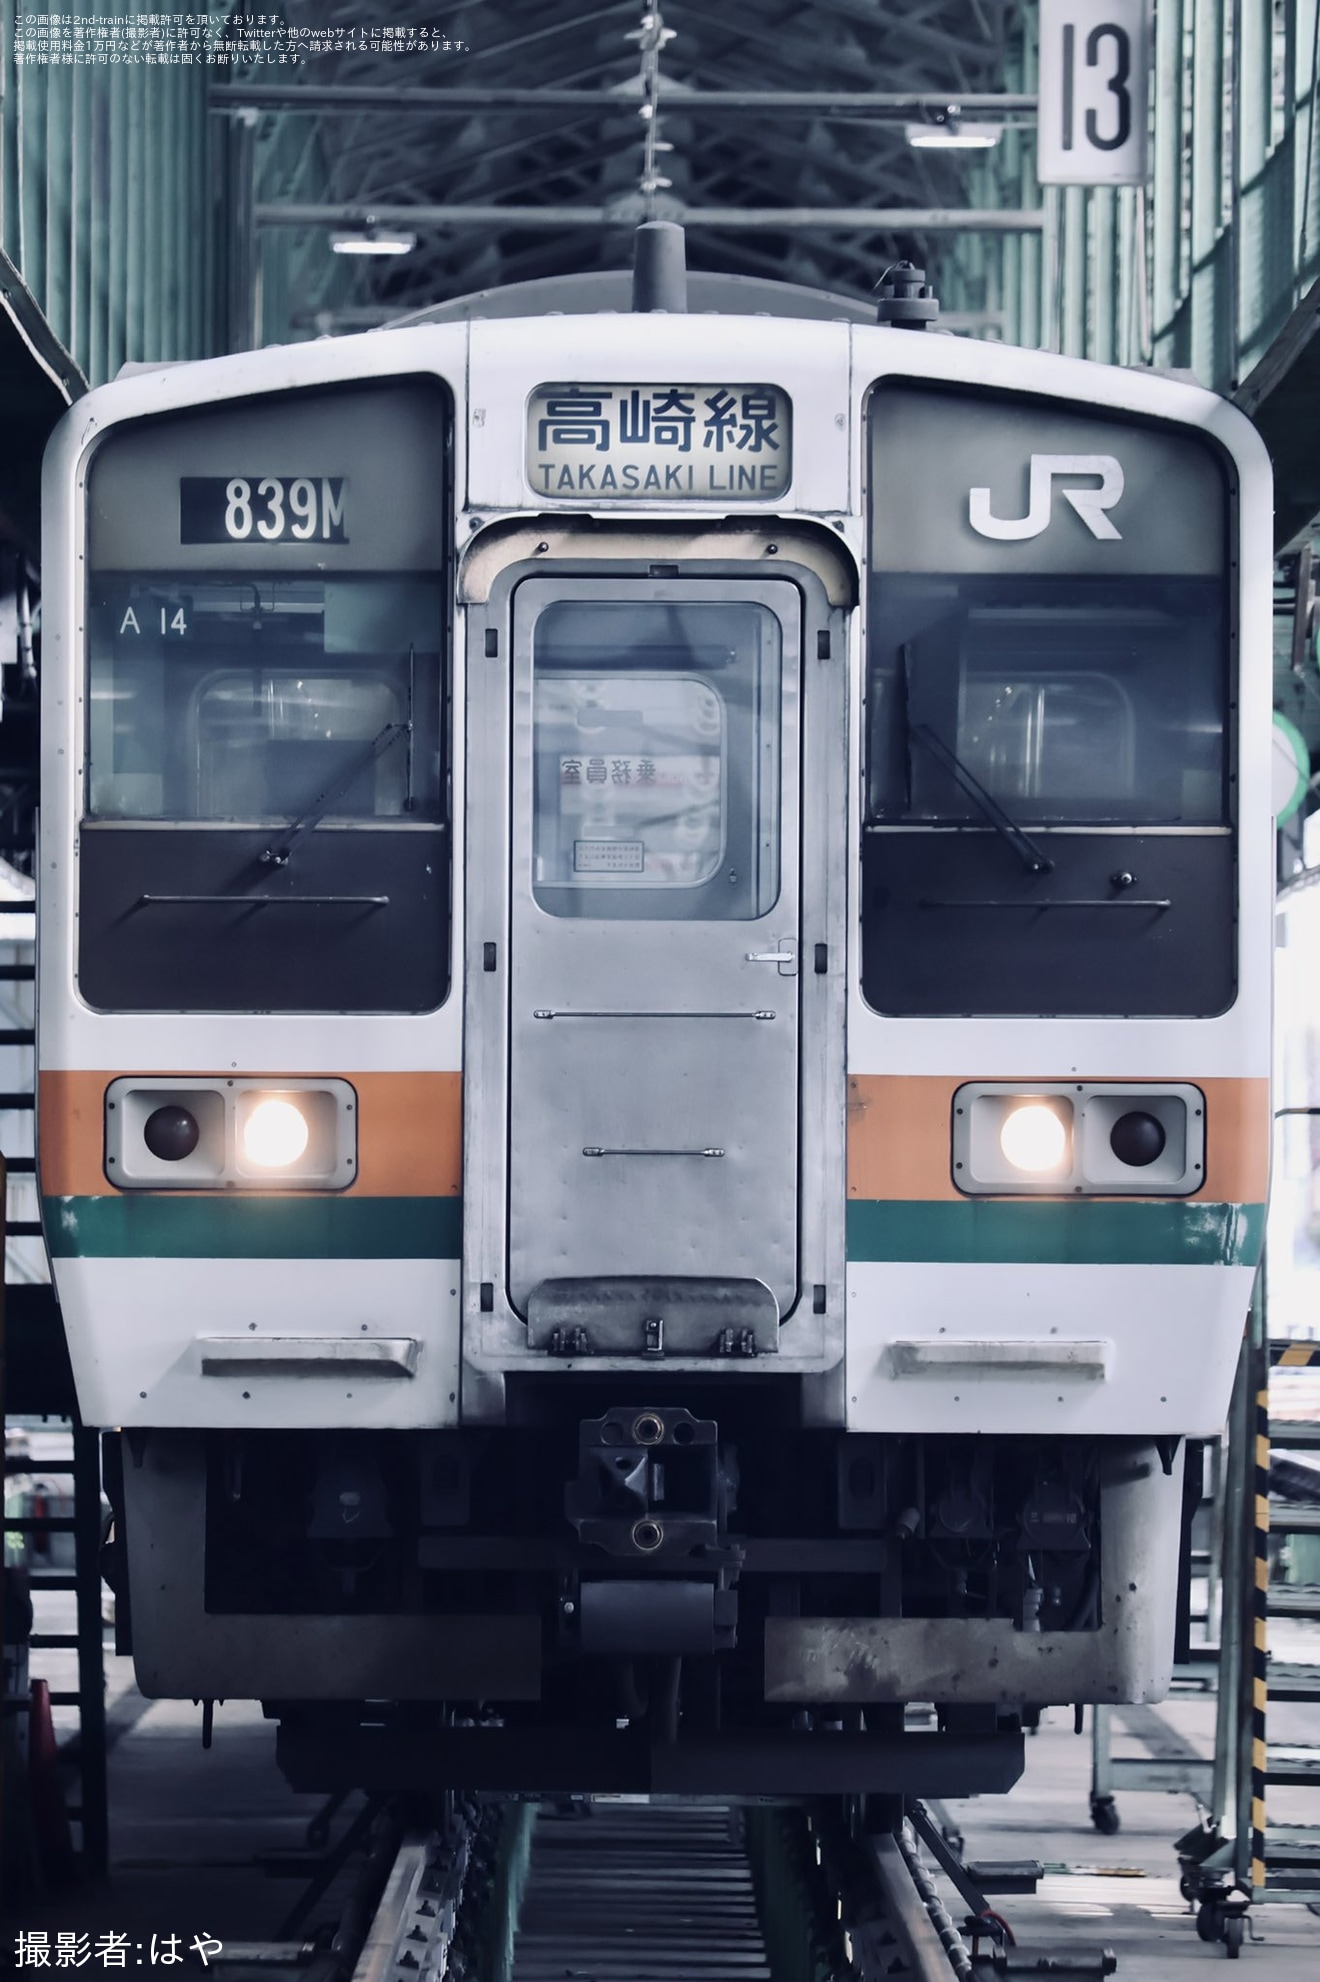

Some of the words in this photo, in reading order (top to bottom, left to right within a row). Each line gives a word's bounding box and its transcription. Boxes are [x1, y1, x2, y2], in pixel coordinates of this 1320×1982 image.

[1062, 23, 1131, 151] 13
[536, 388, 780, 452] 高崎線
[224, 478, 347, 539] 839M
[538, 464, 694, 491] TAKASAKI
[708, 464, 779, 491] LINE
[969, 454, 1125, 540] JR
[120, 606, 141, 635] A
[160, 607, 187, 635] 14
